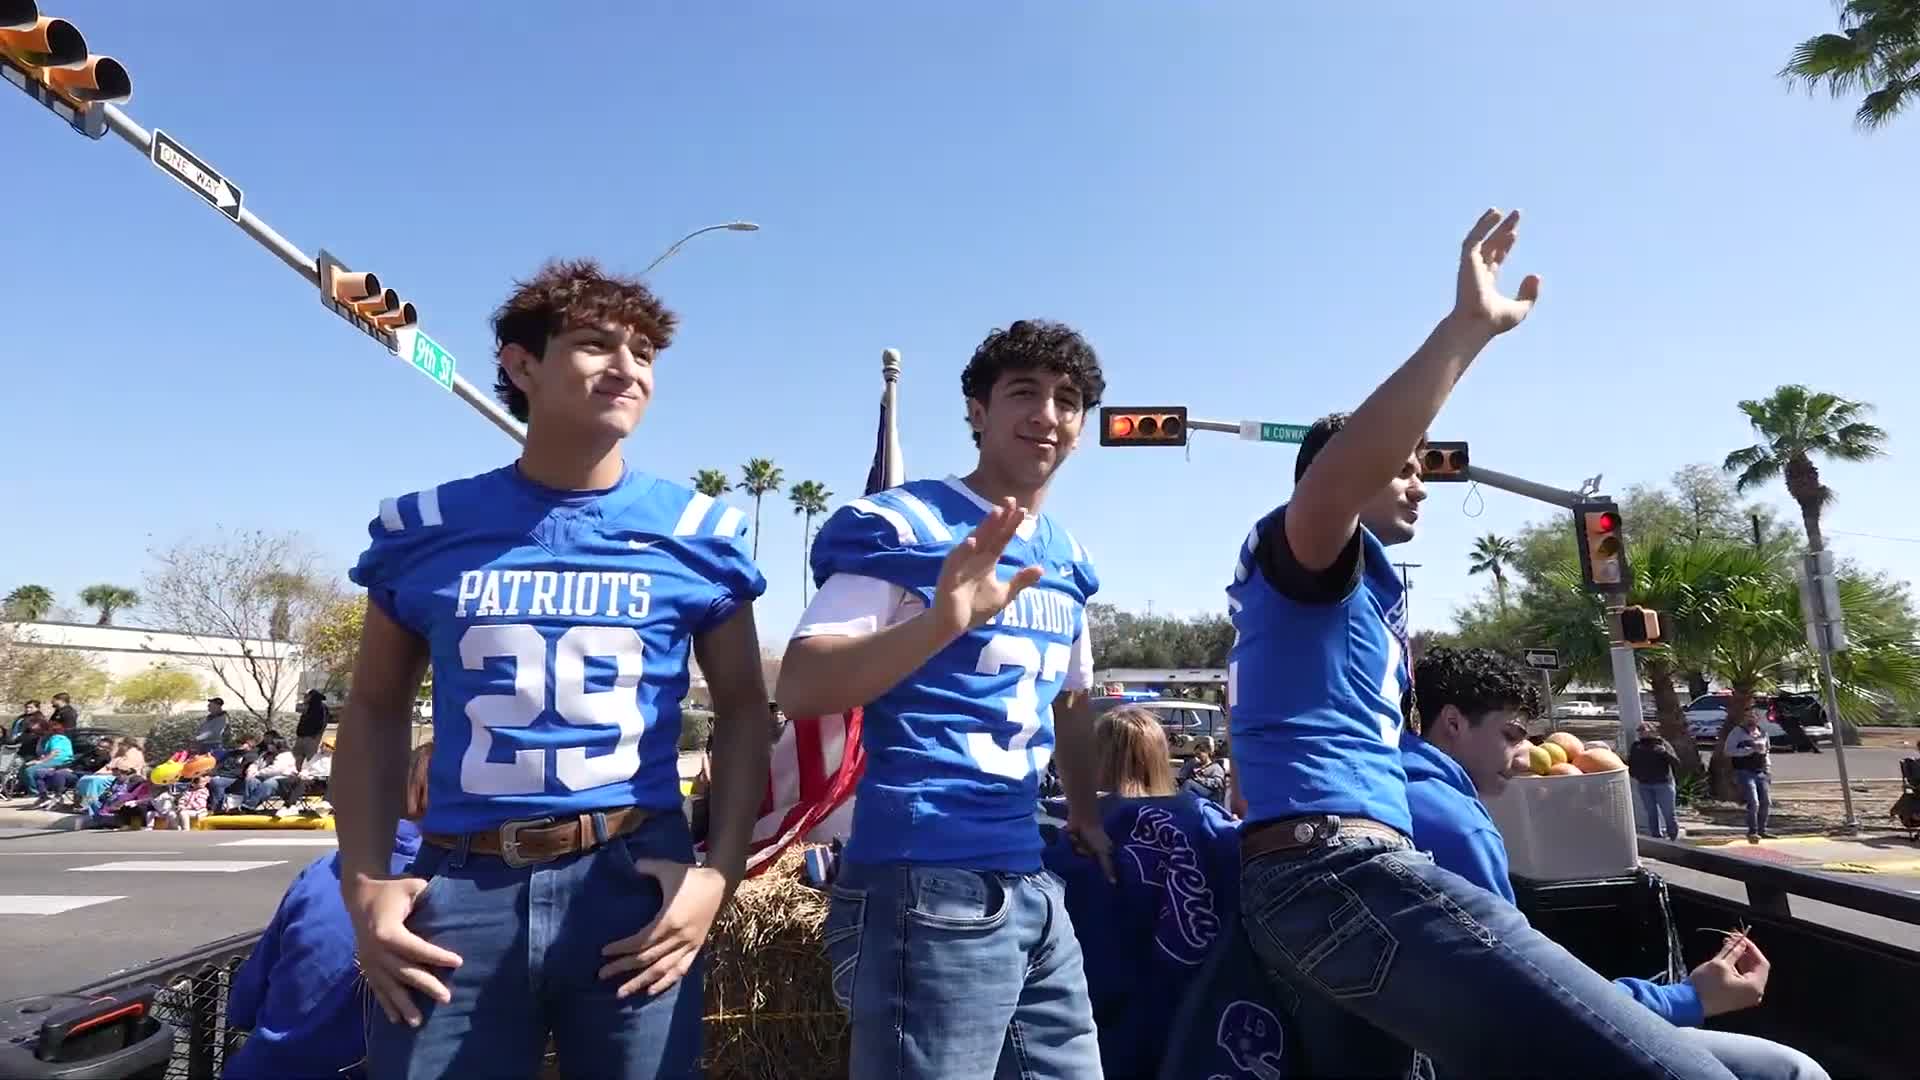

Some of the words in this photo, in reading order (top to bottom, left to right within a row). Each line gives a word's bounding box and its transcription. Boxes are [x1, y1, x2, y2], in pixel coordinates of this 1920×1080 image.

[163, 147, 188, 175] ONE
[196, 170, 219, 195] WAY
[415, 337, 437, 374] 9th
[439, 355, 452, 385] St
[1263, 426, 1271, 438] N
[455, 570, 651, 618] PATRIOTS
[986, 586, 1074, 637] ATRIOT
[459, 624, 645, 795] 29
